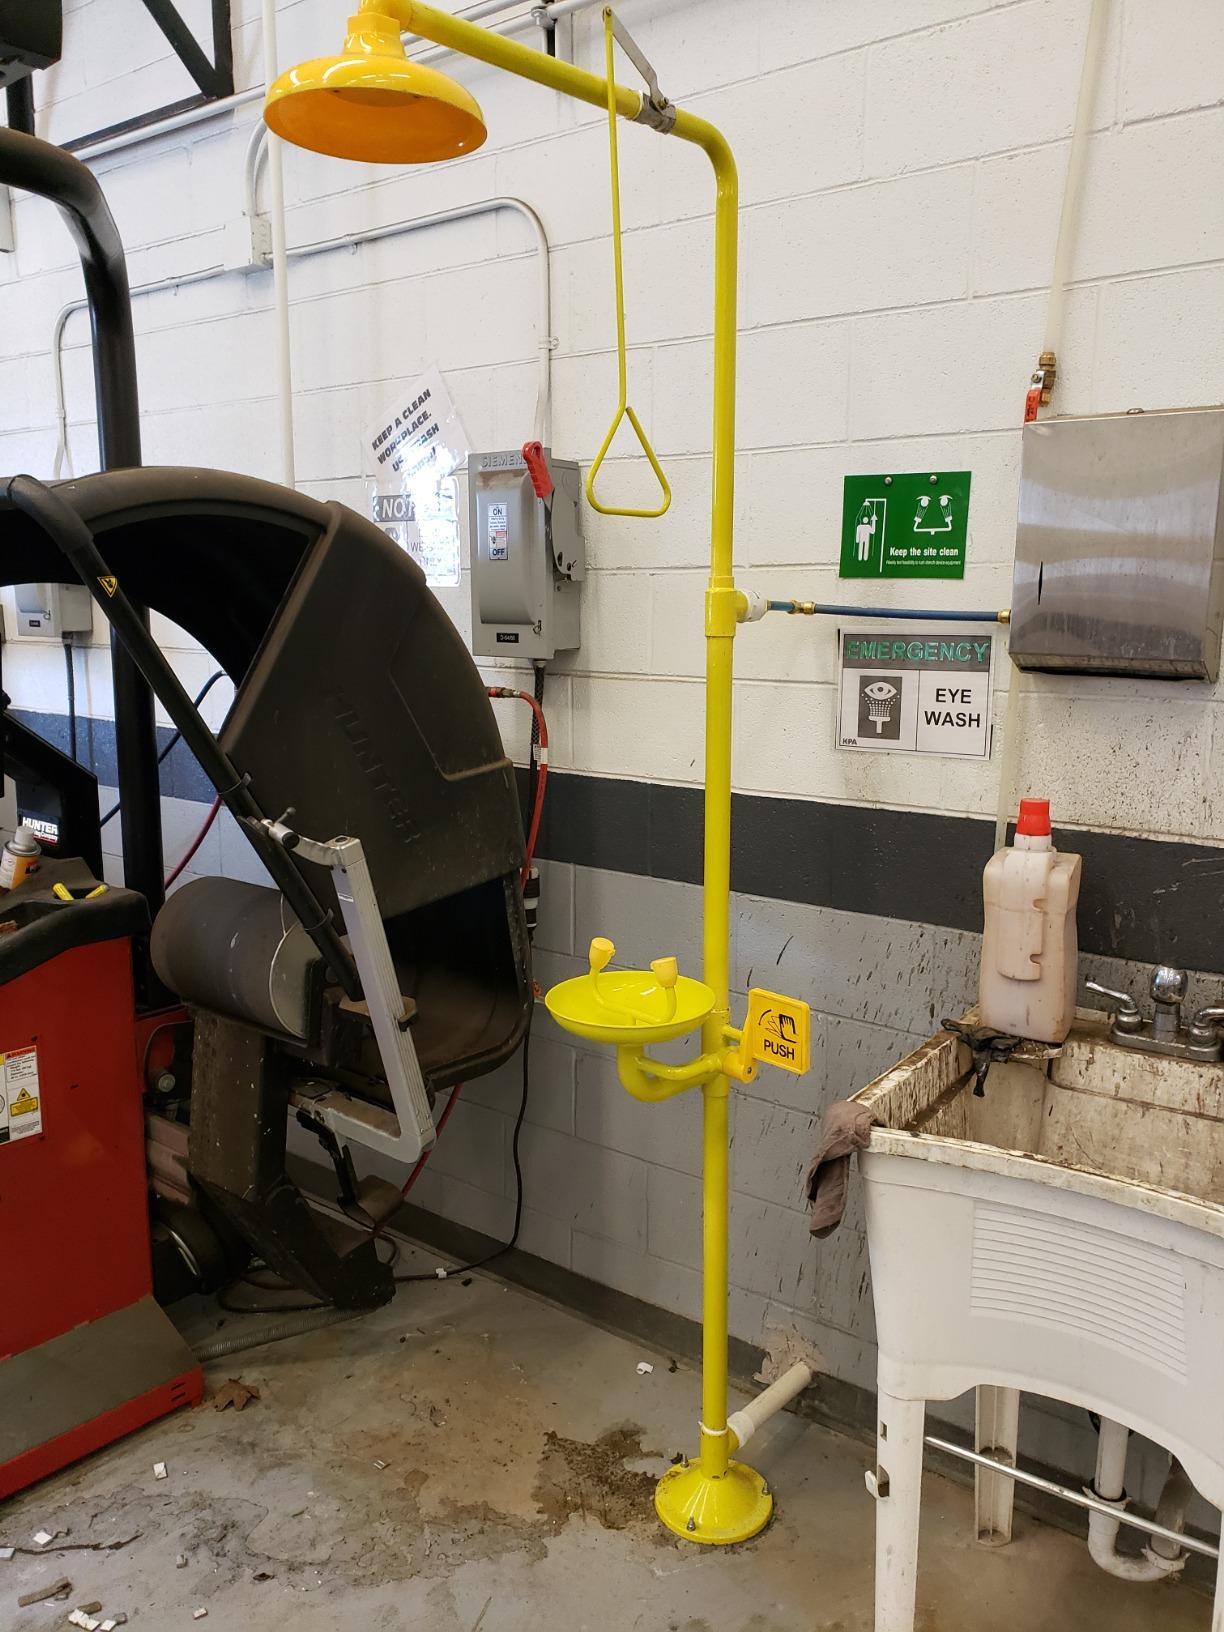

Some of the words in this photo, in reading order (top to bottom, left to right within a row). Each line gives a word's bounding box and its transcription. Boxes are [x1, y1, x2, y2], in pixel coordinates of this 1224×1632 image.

[371, 424, 393, 451] KEEP
[394, 416, 403, 429] A
[402, 388, 432, 420] CLEAN
[480, 452, 528, 468] SIEMEN
[492, 507, 503, 516] ON
[492, 548, 505, 556] OFF
[889, 547, 908, 558] Keep
[910, 547, 921, 556] the
[923, 547, 937, 556] site
[939, 546, 959, 556] clean
[846, 640, 989, 662] EMERGENCY
[935, 688, 972, 704] EYE
[924, 710, 981, 728] WASH
[842, 738, 858, 746] KPA
[22, 816, 58, 835] HUNTER
[763, 1039, 795, 1061] PUSH
